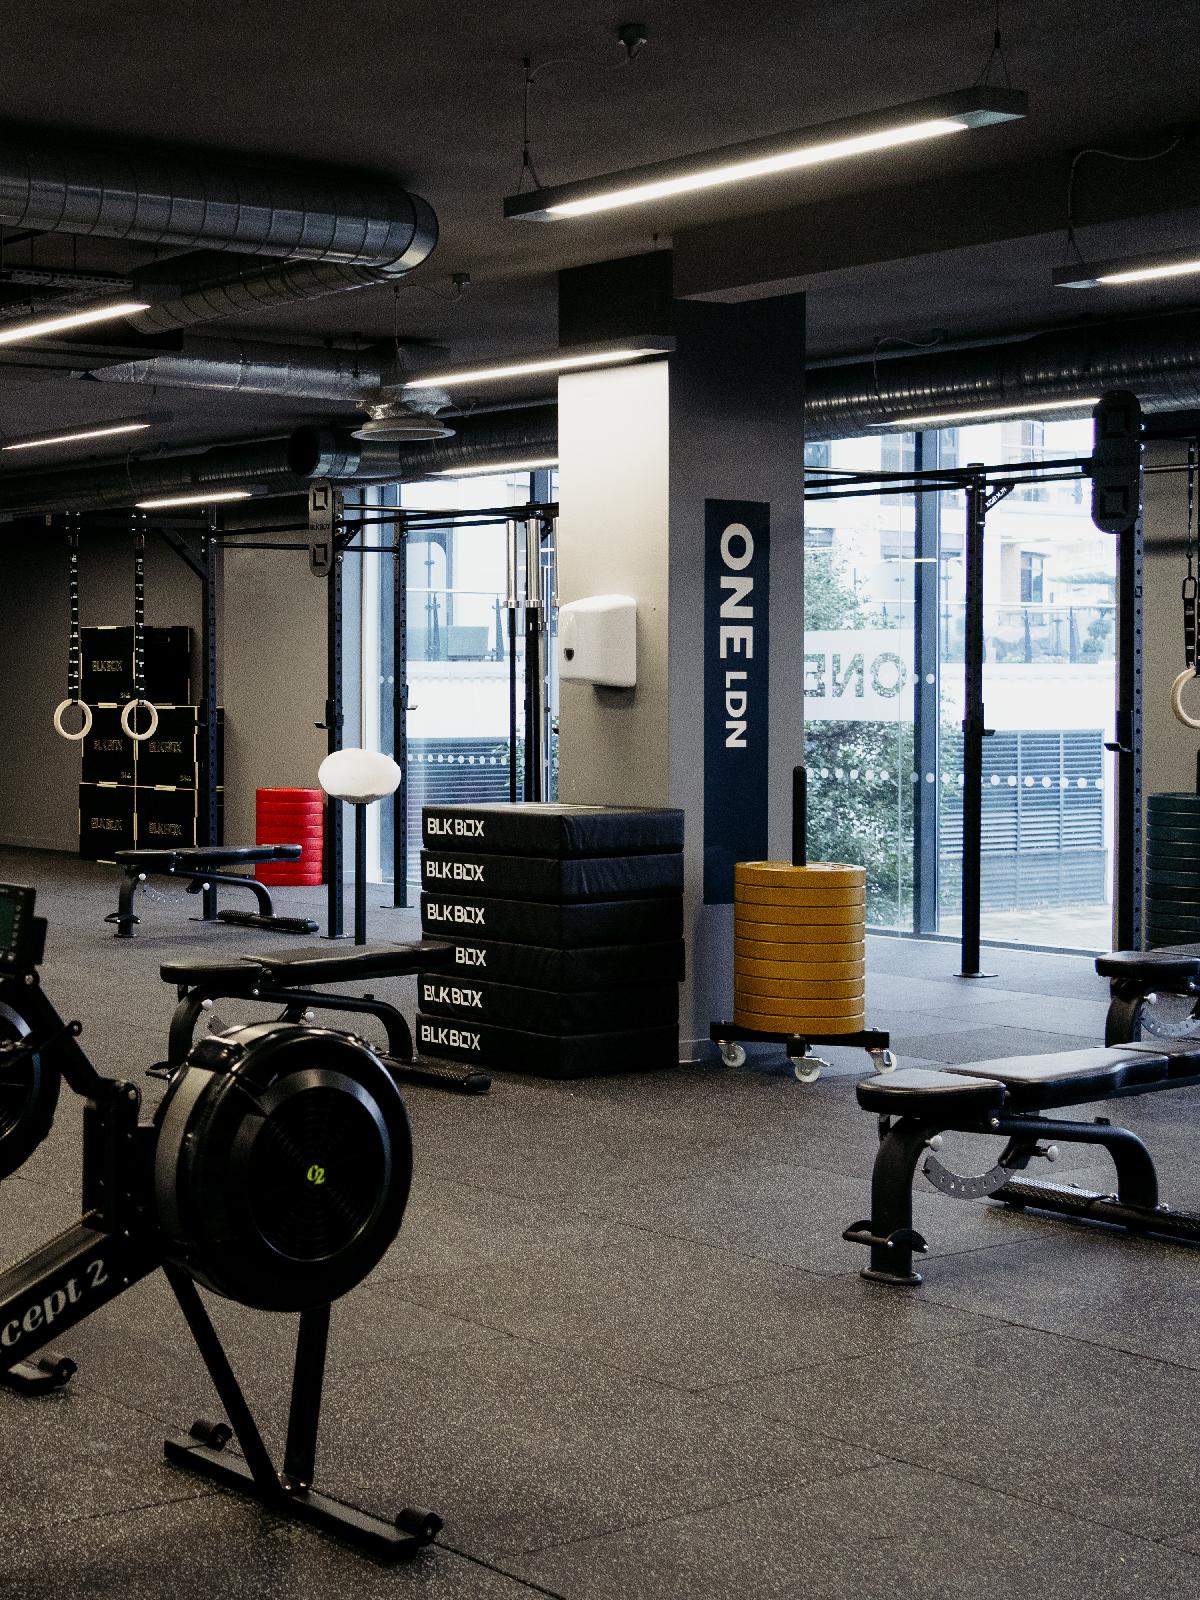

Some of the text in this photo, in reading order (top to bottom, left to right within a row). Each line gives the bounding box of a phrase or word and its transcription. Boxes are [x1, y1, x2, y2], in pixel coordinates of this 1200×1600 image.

[720, 523, 754, 748] ONE LDN
[455, 946, 487, 967] BOX
[85, 1259, 109, 1288] 2
